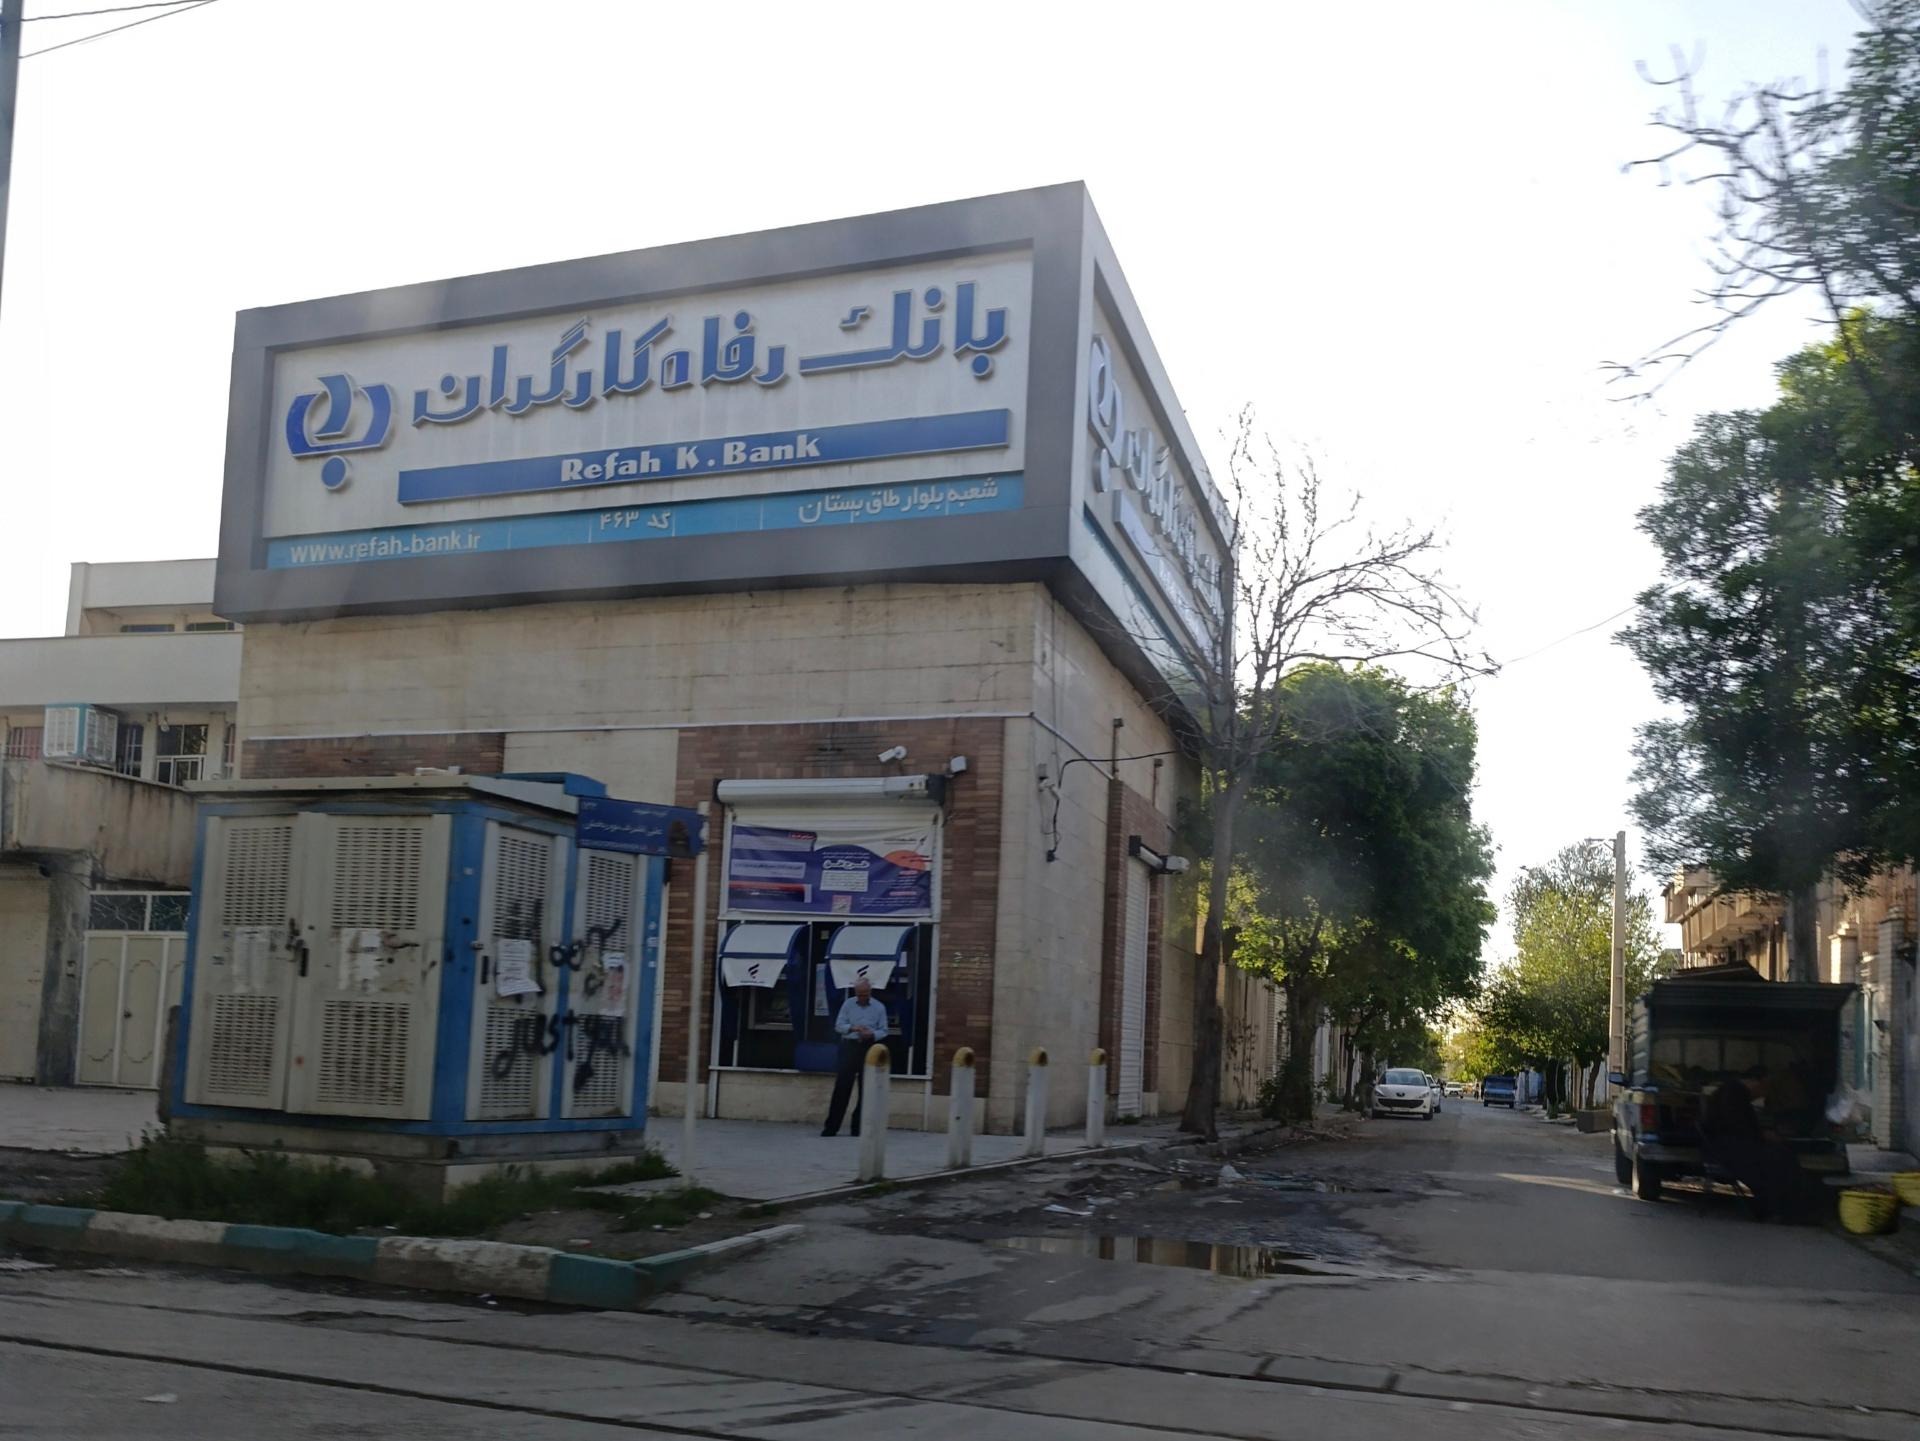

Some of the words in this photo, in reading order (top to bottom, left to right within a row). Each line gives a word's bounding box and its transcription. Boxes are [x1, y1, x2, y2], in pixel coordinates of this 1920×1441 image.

[800, 282, 1009, 378] بانک
[660, 310, 788, 389] رفاه
[413, 314, 672, 427] کارگران
[560, 452, 661, 482] Refah
[723, 434, 820, 467] Bank
[865, 489, 901, 515] طاق
[903, 486, 945, 510] بلوار
[951, 478, 998, 506] شعبه
[600, 511, 640, 530] ۴۶۳
[647, 509, 672, 529] کد
[798, 495, 864, 524] بستان
